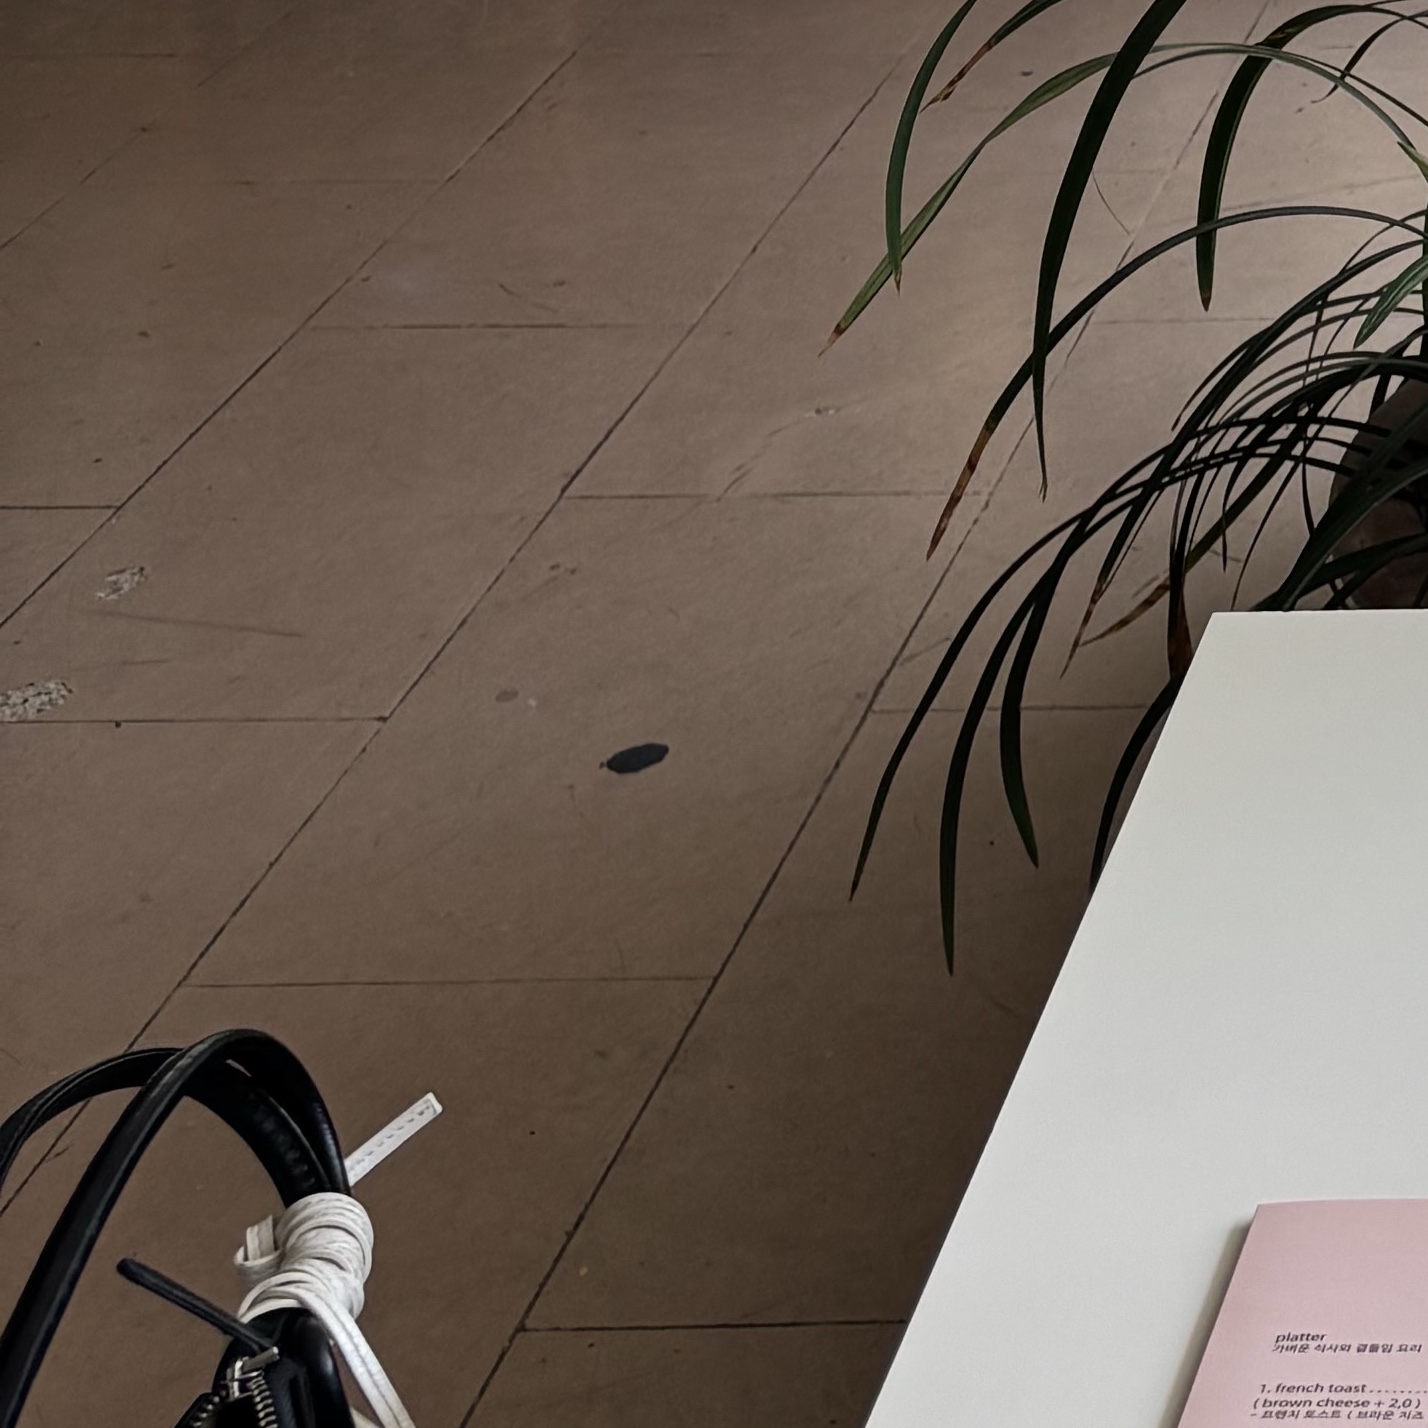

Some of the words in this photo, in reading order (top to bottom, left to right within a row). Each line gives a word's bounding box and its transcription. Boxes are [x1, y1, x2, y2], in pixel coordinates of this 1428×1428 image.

[1274, 1332, 1327, 1346] platter
[1396, 1343, 1423, 1354] 요리
[1260, 1383, 1271, 1395] 1.
[1274, 1382, 1325, 1394] french
[1316, 1398, 1371, 1408] cheese
[1303, 1410, 1342, 1420] 토스트
